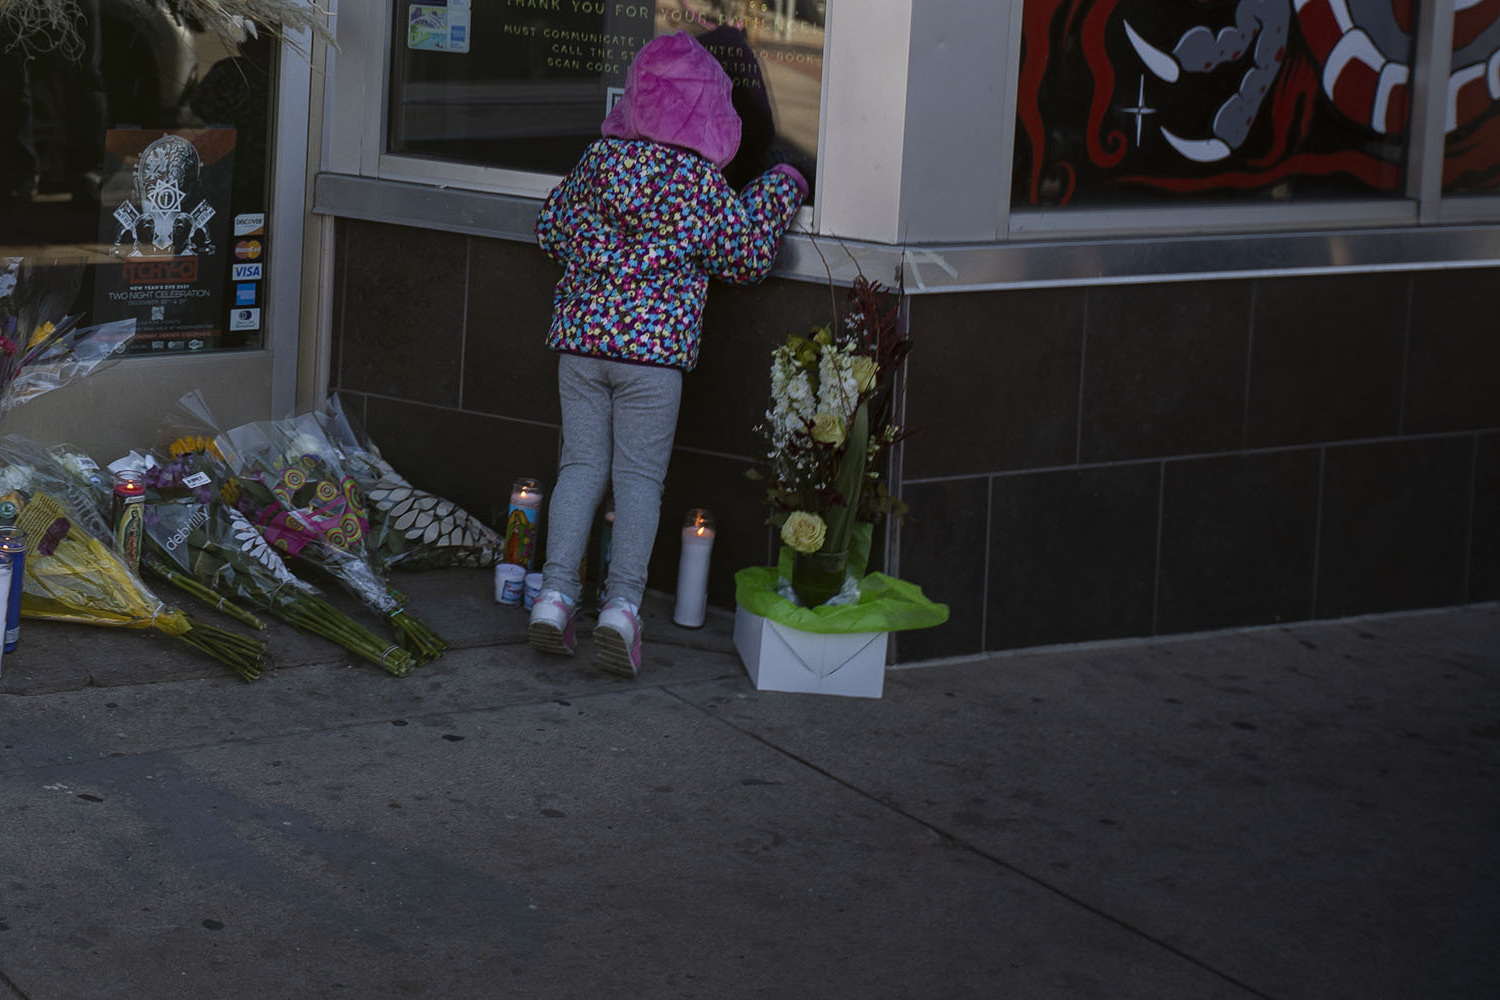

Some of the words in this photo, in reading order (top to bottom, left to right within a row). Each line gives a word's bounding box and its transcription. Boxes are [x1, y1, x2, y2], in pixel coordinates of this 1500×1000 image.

[615, 4, 650, 19] FOR
[660, 8, 707, 25] YOUR
[503, 25, 537, 38] MUST
[542, 29, 635, 48] COMMUNICATE
[551, 43, 582, 56] CALL
[591, 47, 613, 60] THE
[547, 57, 580, 70] SCAN
[585, 61, 620, 74] CODE
[236, 218, 263, 226] DISCOVER
[235, 265, 261, 278] VISA
[108, 292, 129, 300] TWO
[129, 291, 154, 300] NIGHT
[155, 289, 211, 299] CELEBRATION
[165, 521, 194, 551] debi
